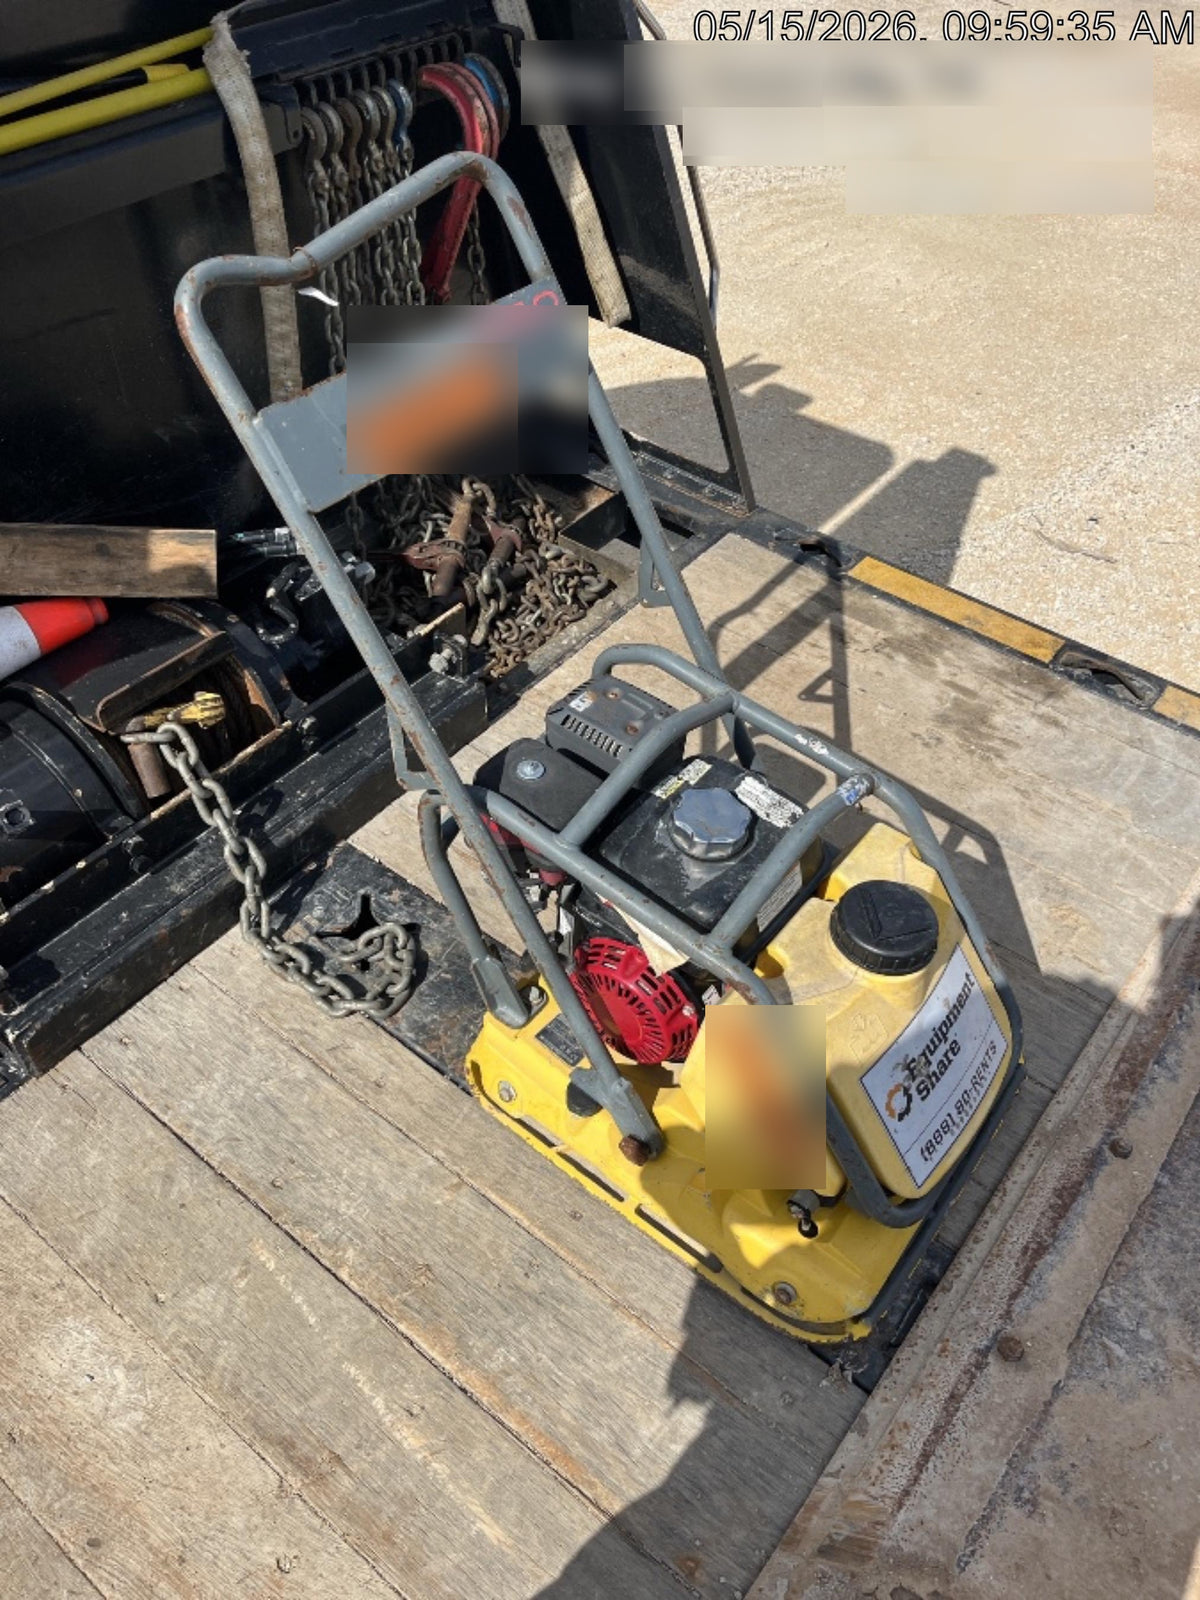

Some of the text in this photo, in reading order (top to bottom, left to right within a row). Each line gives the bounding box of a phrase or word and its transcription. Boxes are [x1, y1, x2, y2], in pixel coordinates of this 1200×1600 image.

[915, 1038, 962, 1102] Share
[920, 1040, 998, 1162] (888) 80-RENTS
